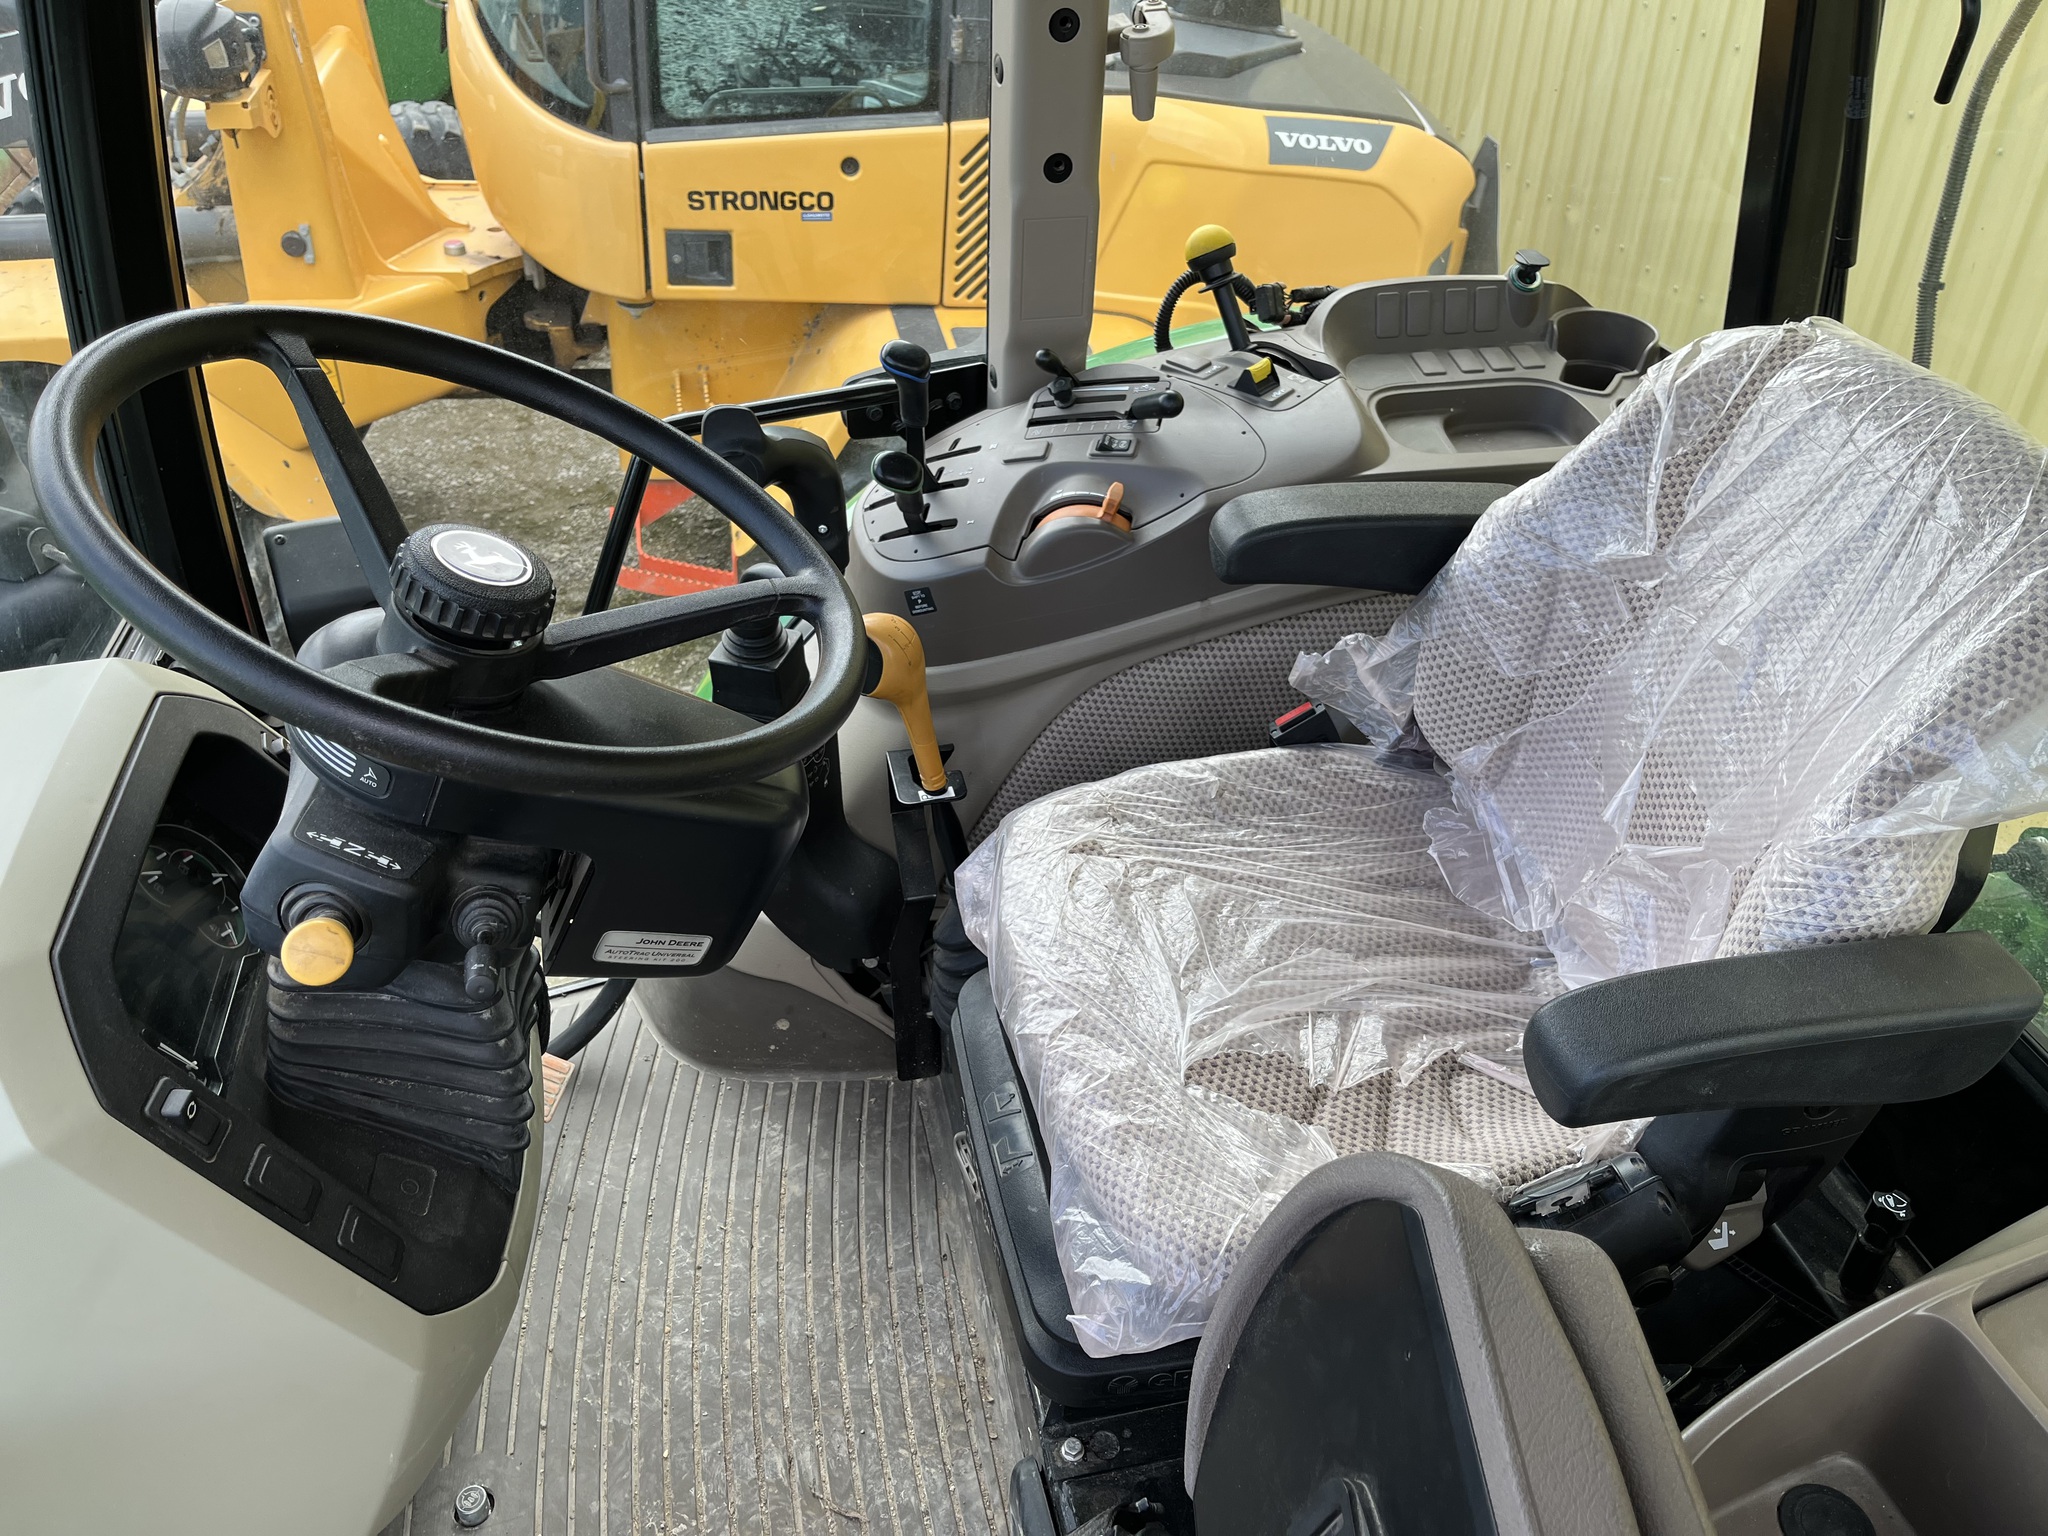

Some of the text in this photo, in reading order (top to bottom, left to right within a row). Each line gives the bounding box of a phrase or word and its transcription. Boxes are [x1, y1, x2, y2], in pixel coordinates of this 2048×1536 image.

[1274, 131, 1373, 154] VOLVO
[687, 190, 834, 211] STRONGCO
[360, 776, 378, 788] AUTO
[635, 938, 705, 948] JOHN DEERE
[651, 950, 696, 959] UNIVERSAL
